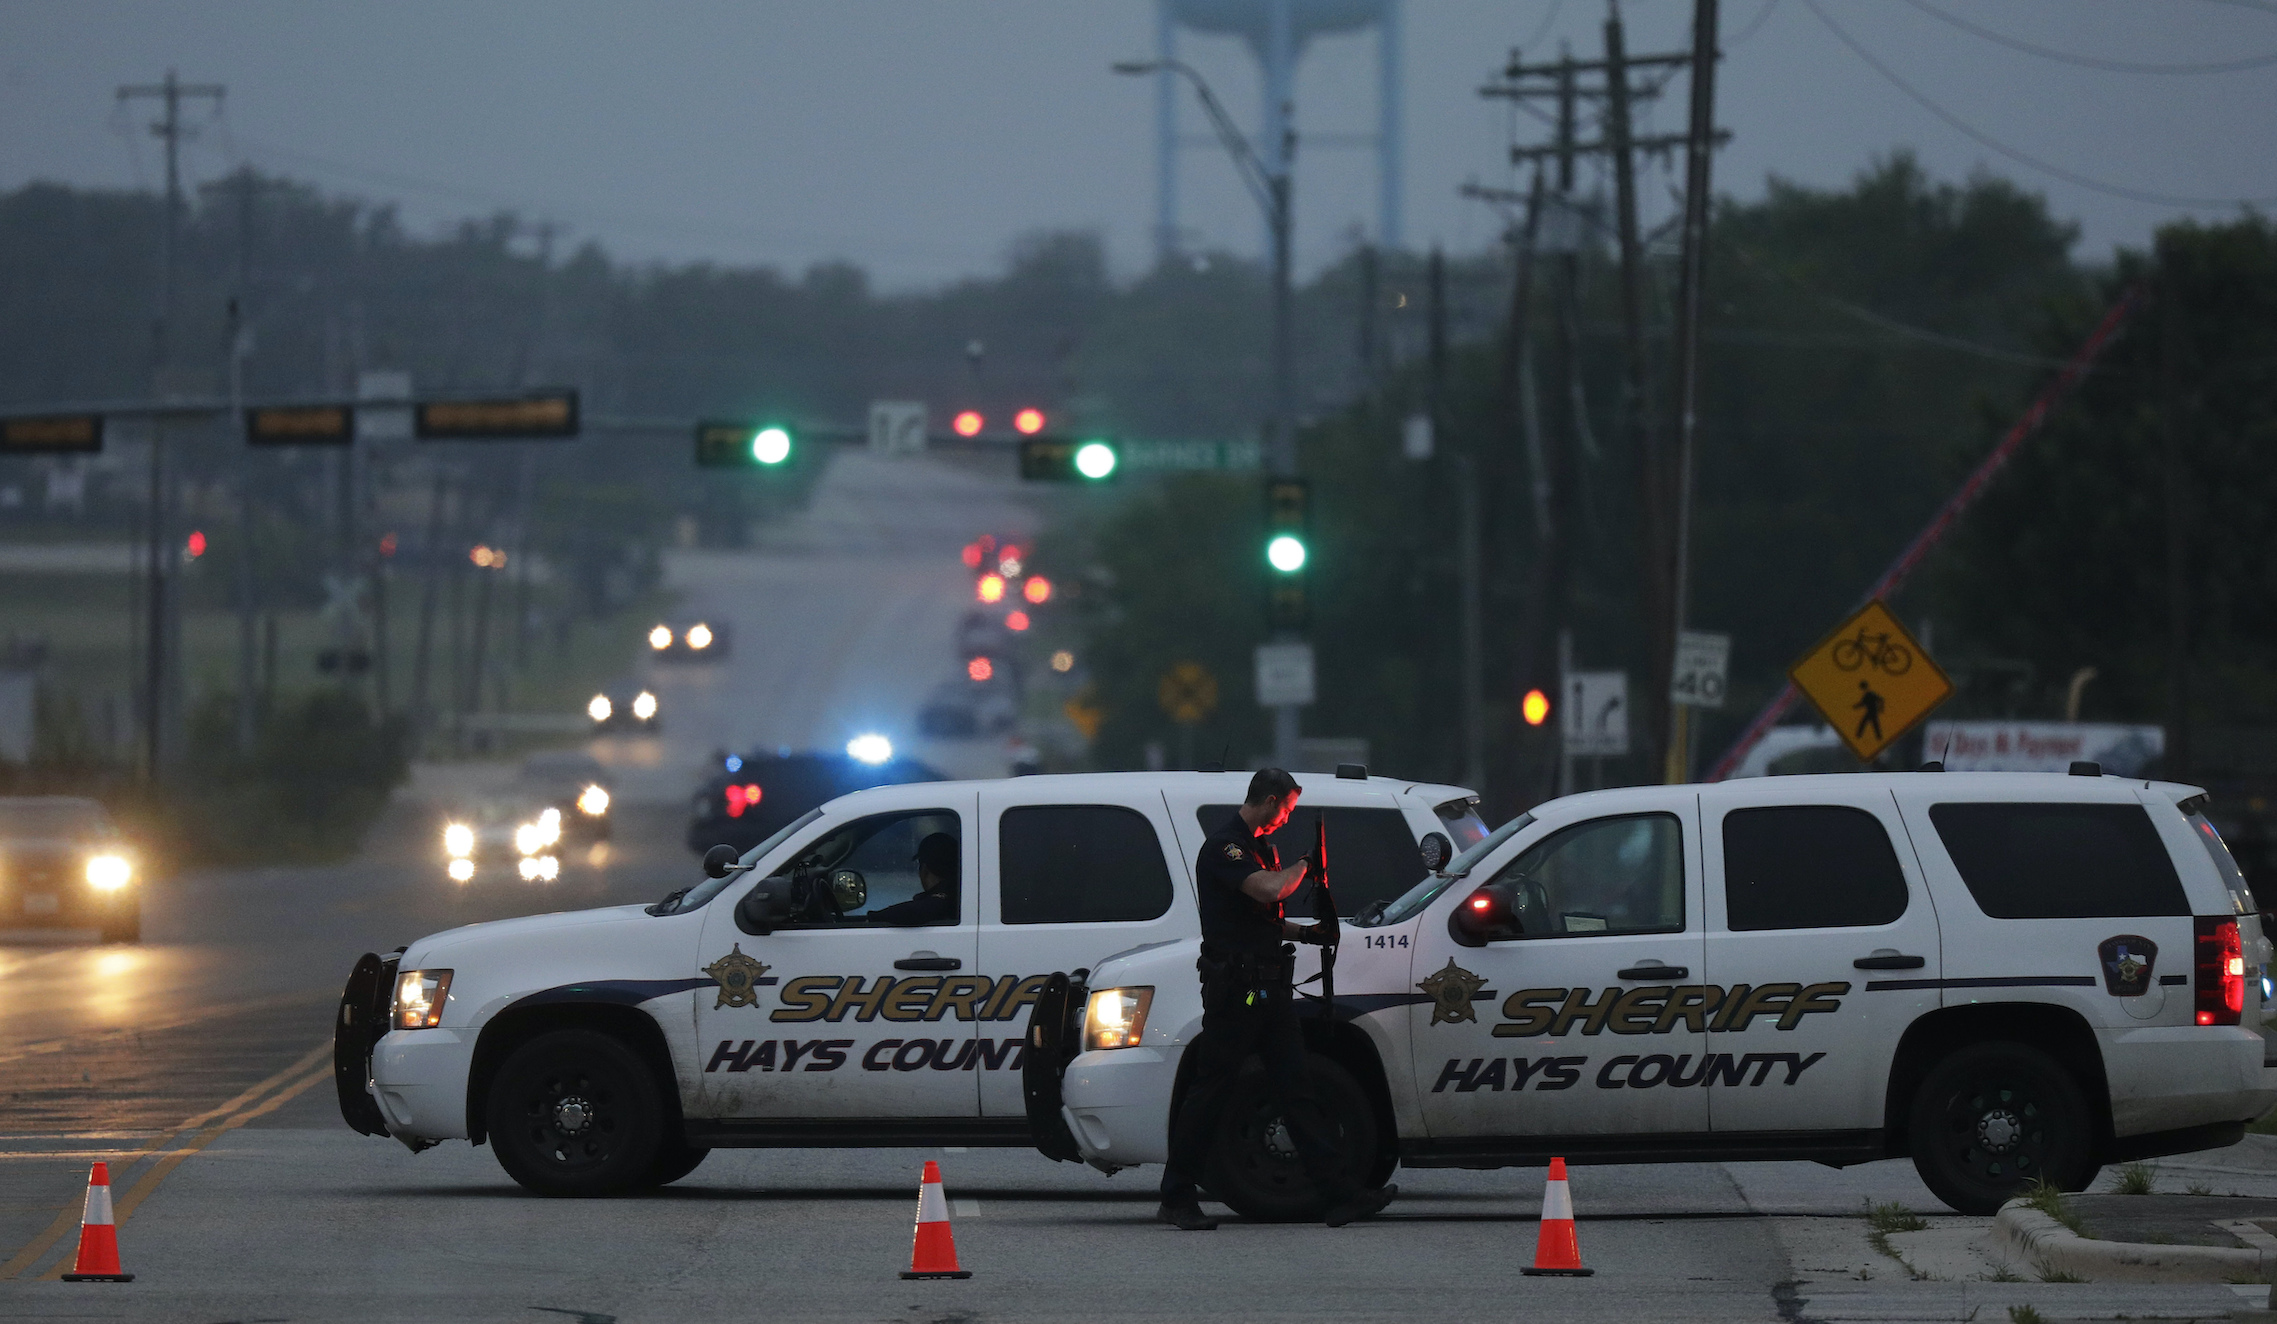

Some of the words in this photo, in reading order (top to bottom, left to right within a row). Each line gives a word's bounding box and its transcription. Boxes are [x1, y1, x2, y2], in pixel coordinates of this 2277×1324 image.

[1671, 671, 1724, 699] 40
[1364, 934, 1409, 949] 1414
[769, 975, 1052, 1023] SHERIF
[1491, 981, 1852, 1037] SHERIFF
[705, 1039, 855, 1072] HAYS
[862, 1038, 1028, 1071] COUNT
[1431, 1056, 1588, 1092] HAYS
[1596, 1052, 1827, 1089] COUNTY
